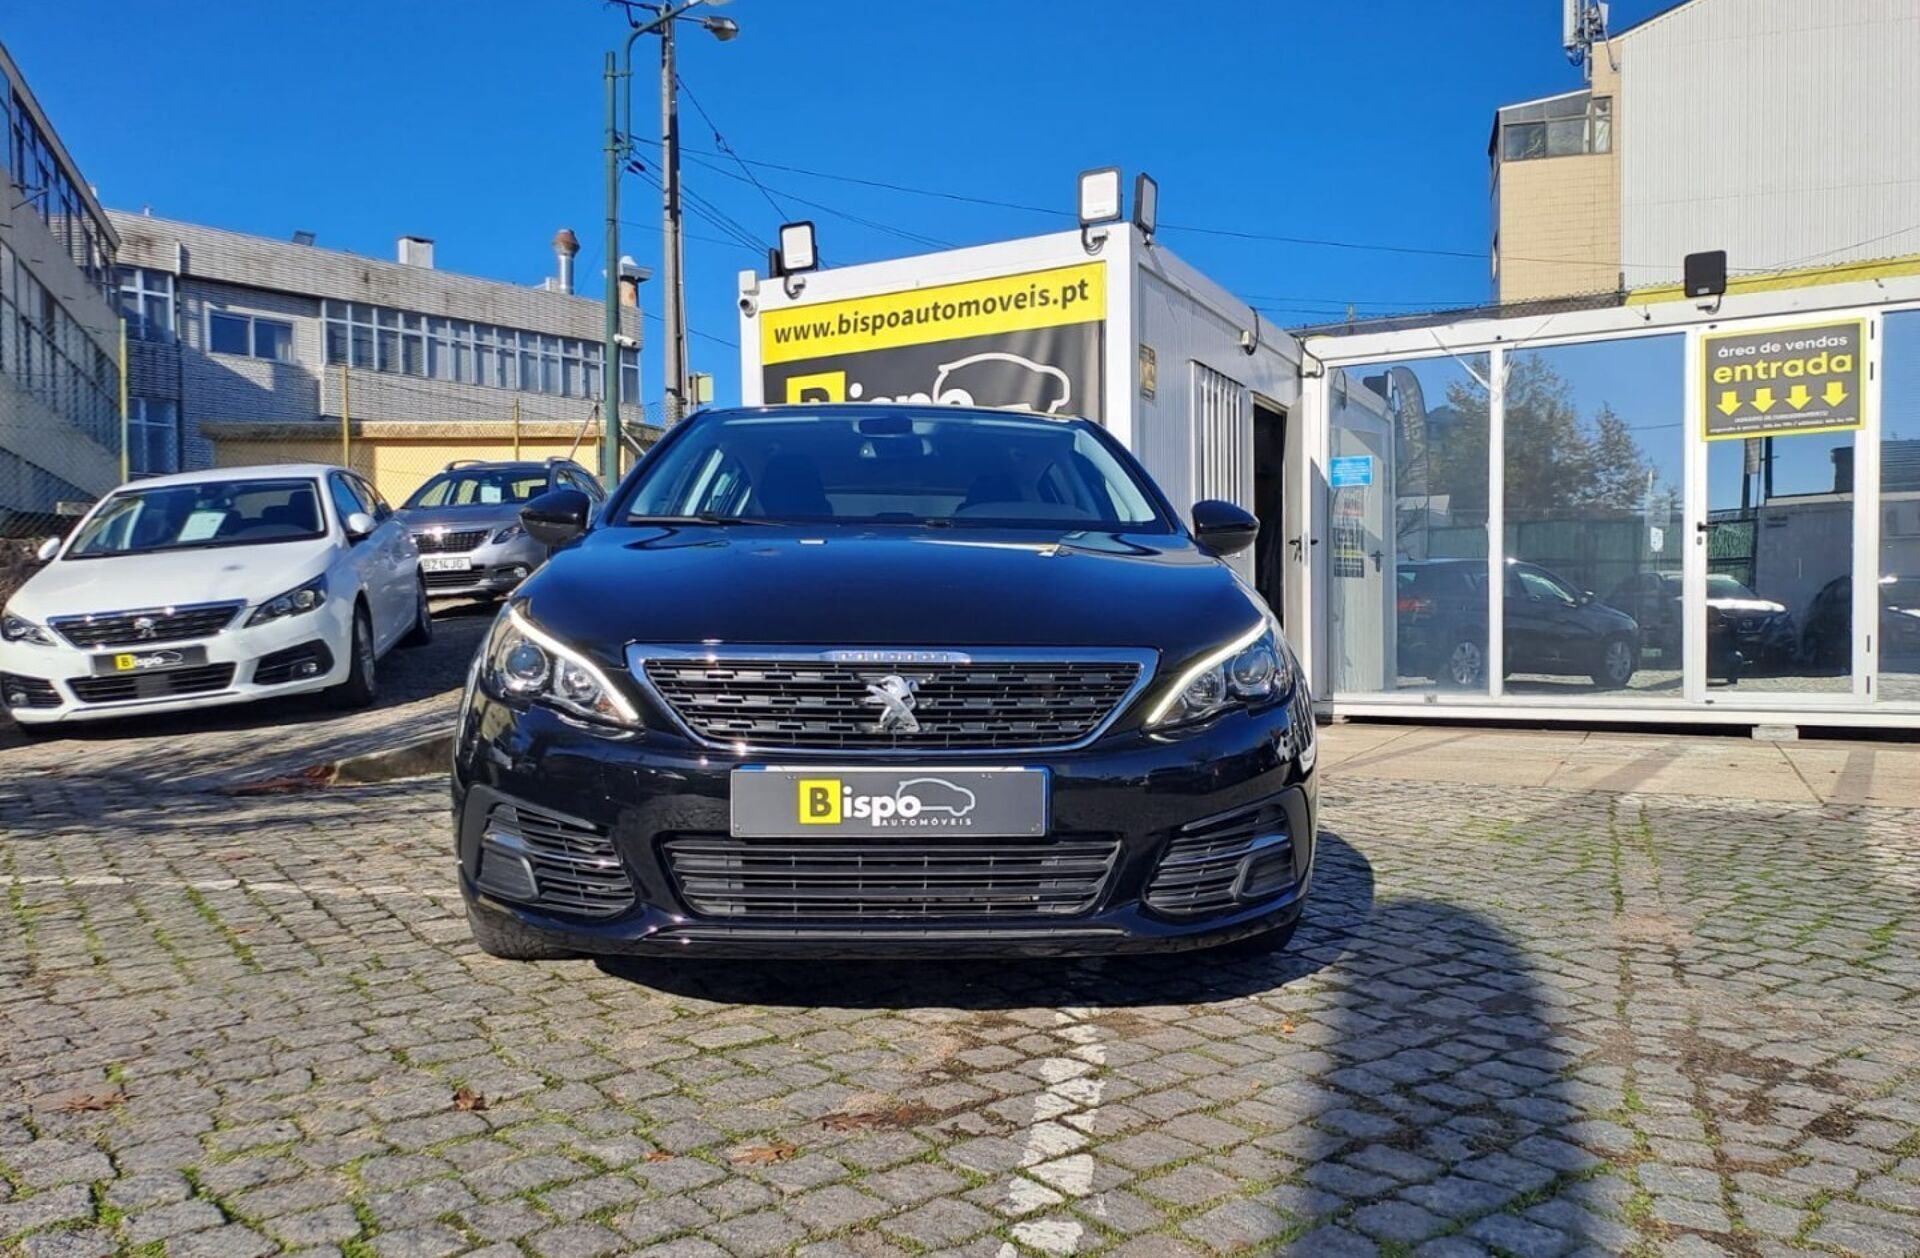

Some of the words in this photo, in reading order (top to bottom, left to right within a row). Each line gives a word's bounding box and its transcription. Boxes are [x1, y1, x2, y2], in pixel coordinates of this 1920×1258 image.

[774, 278, 1089, 344] www.bispoautomoveis.pt
[1718, 345, 1756, 358] área
[1760, 341, 1781, 353] de
[1785, 335, 1848, 351] vendas
[1713, 351, 1853, 384] entrada
[810, 785, 922, 827] Bispo
[881, 817, 973, 827] AUTOMÓVEIS
